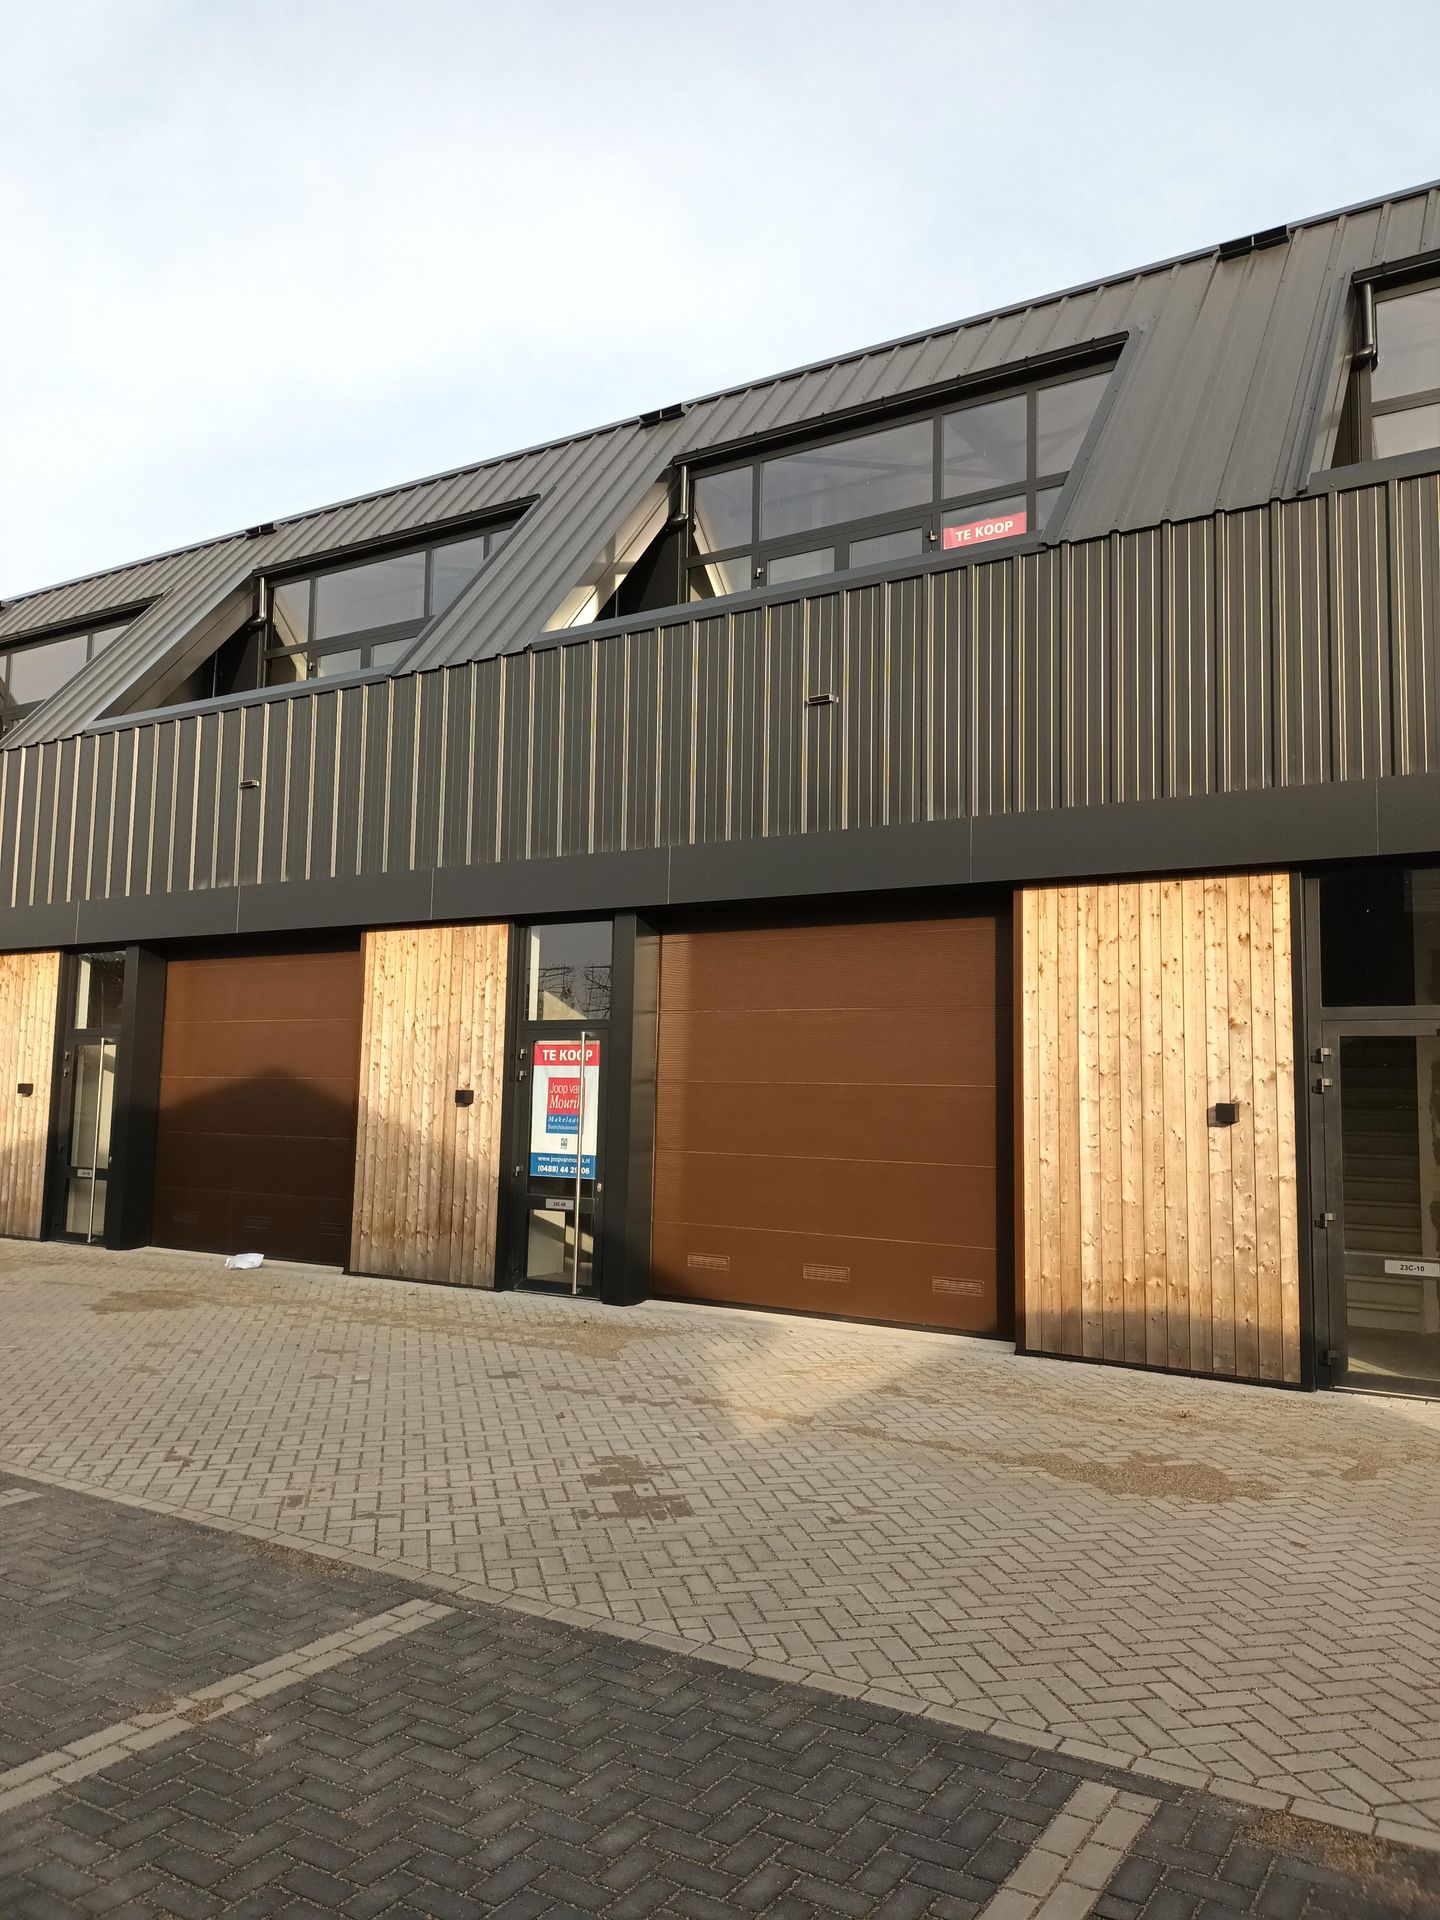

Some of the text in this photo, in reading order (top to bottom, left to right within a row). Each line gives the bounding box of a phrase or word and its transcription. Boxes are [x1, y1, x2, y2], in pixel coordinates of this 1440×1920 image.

[955, 520, 1014, 542] TE KOOP
[542, 1049, 557, 1061] TE
[549, 1082, 568, 1096] Joop
[537, 1164, 559, 1174] (0488)
[560, 1166, 569, 1174] 44
[1399, 1264, 1425, 1272] 23C-10
